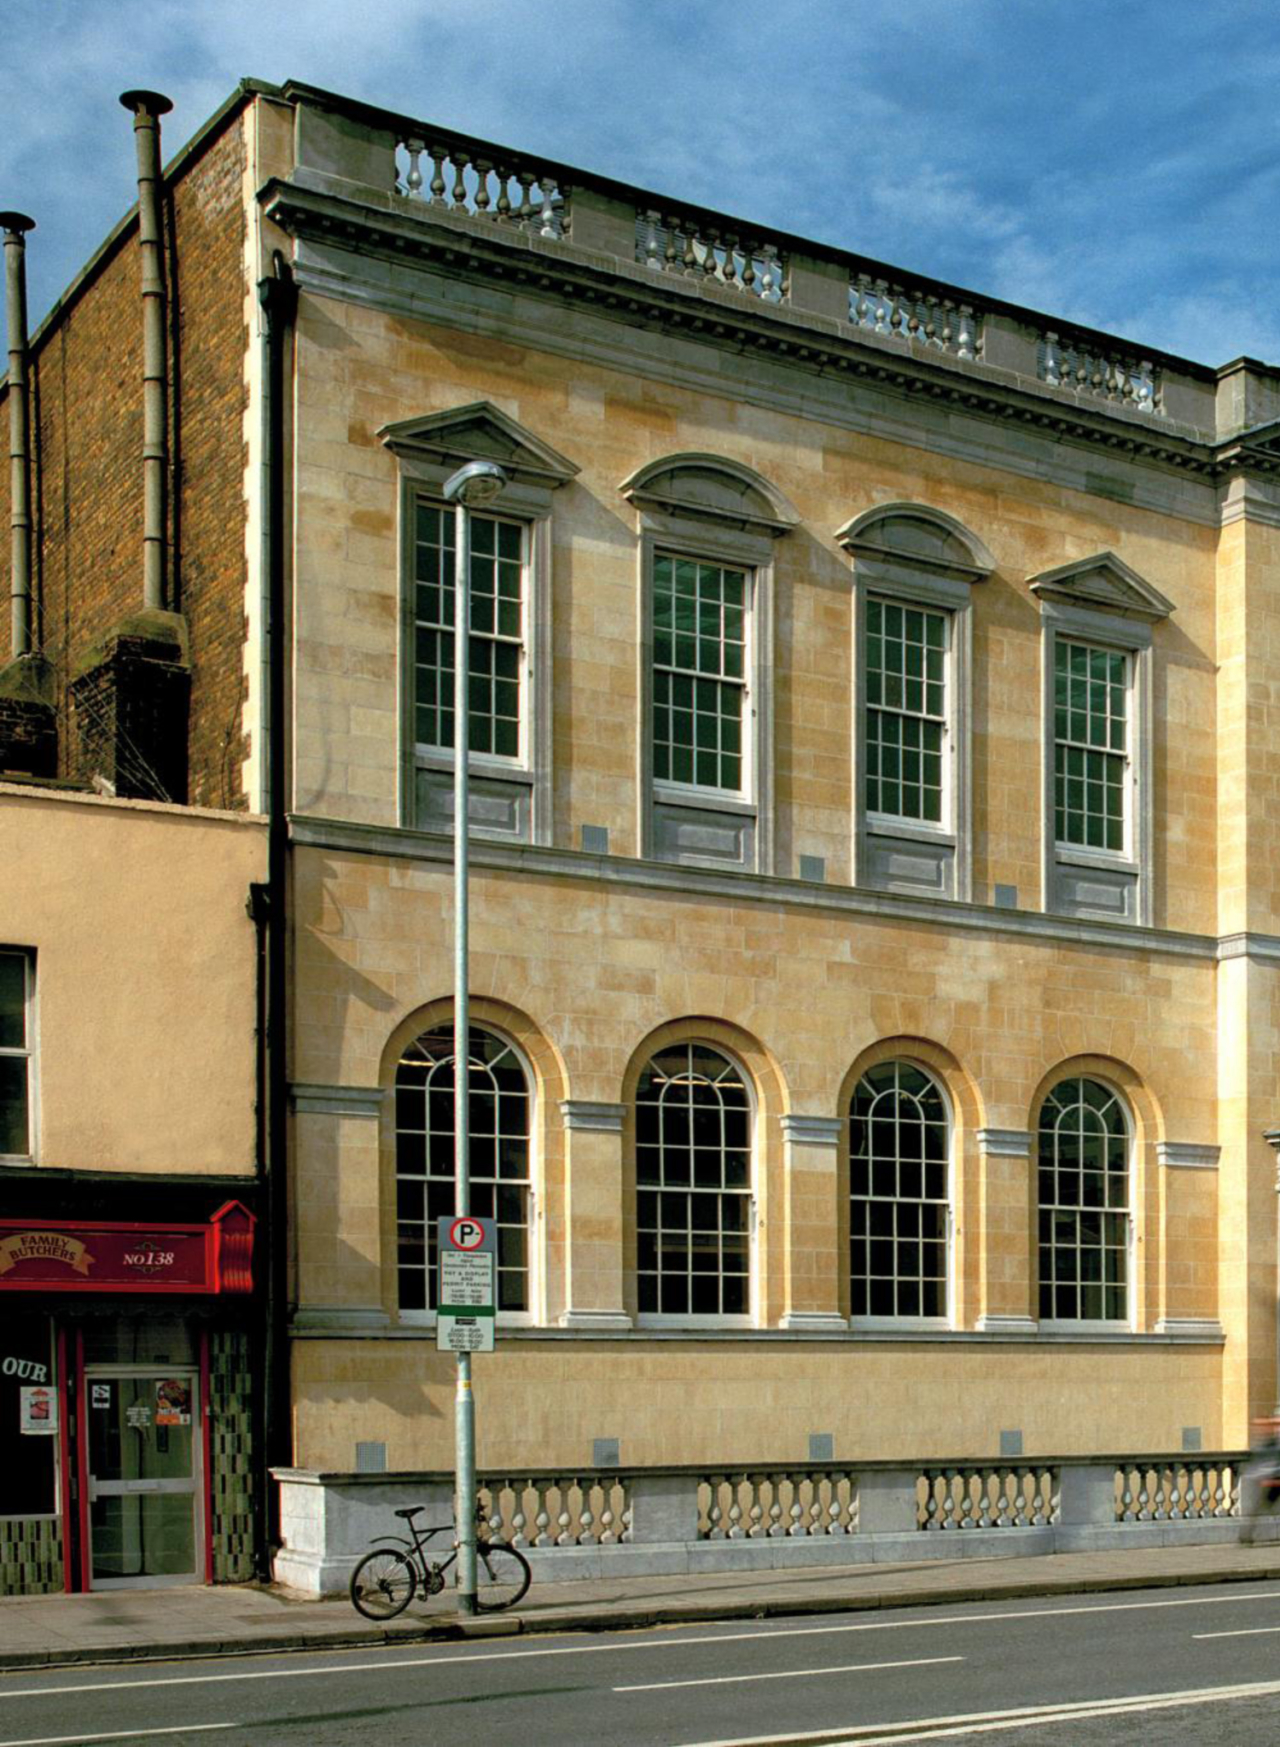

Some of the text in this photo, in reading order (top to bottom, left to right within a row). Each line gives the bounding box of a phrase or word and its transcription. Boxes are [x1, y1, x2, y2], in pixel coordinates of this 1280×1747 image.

[20, 1235, 70, 1249] FAMILY
[460, 1223, 475, 1244] P
[9, 1245, 77, 1262] BUTCHERS
[2, 1356, 47, 1383] OUR
